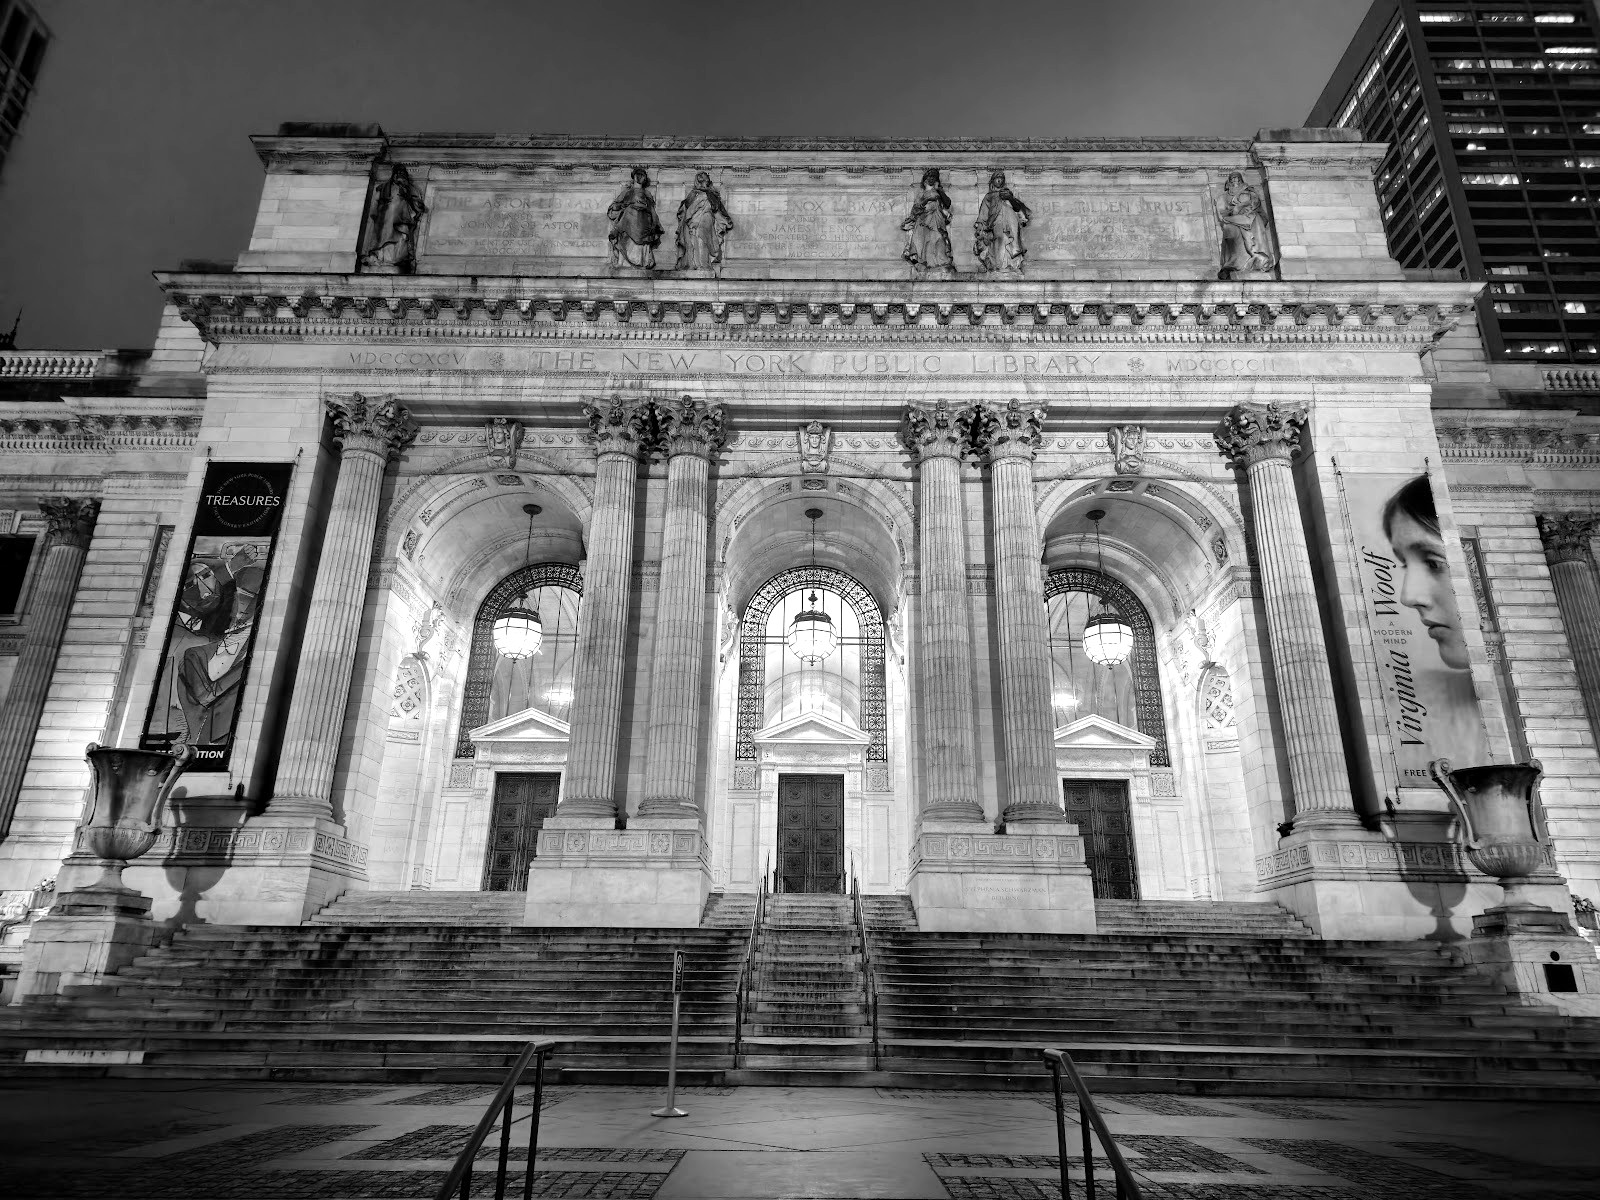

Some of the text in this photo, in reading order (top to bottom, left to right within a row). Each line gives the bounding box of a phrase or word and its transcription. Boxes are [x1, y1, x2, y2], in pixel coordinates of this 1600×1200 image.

[481, 197, 531, 210] ASTOR
[542, 221, 579, 230] ASTOR
[771, 224, 863, 233] JAMES LENOX
[532, 351, 597, 370] THE
[621, 353, 698, 371] NEW
[725, 354, 805, 373] YORK
[832, 355, 942, 374] PUBLIC
[971, 355, 1101, 374] LIBRARY
[205, 495, 281, 507] TREASURES
[1361, 545, 1400, 616] Woolf
[1385, 650, 1428, 747] Virginia
[1404, 769, 1428, 777] FREE
